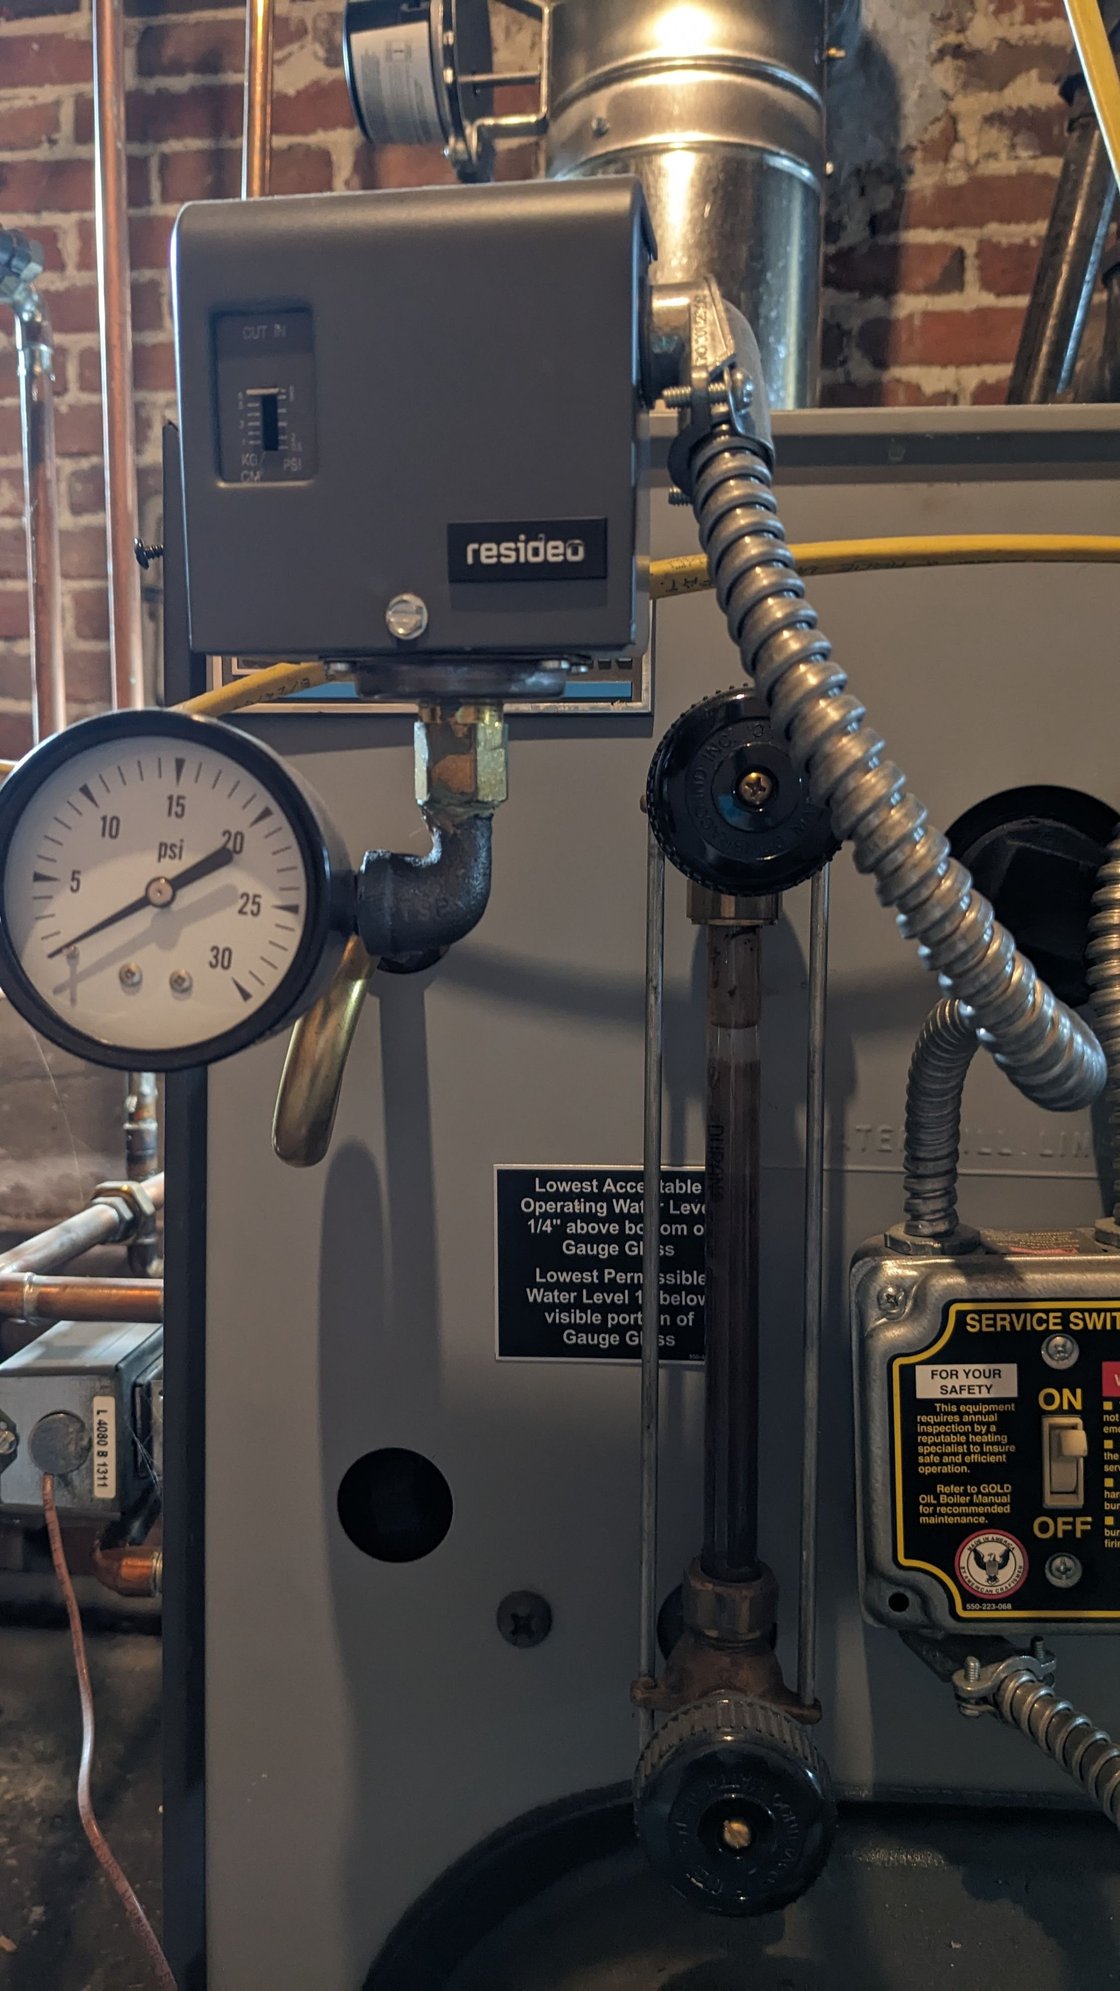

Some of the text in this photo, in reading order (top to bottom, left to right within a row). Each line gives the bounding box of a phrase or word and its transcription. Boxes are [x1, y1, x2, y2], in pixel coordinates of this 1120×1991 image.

[243, 325, 267, 340] CUT
[284, 458, 302, 471] PSI
[466, 534, 585, 565] resideo
[166, 794, 186, 818] 15
[100, 816, 120, 839] 10
[222, 830, 244, 854] 20
[158, 839, 184, 863] psi
[70, 870, 81, 893] 5
[238, 892, 261, 916] 25
[209, 947, 232, 970] 30
[535, 1177, 702, 1194] Lowest Accetable
[520, 1198, 607, 1217] Operating
[527, 1218, 705, 1236] 1/4" above boom o
[562, 1239, 675, 1258] Gauge Glss
[535, 1268, 706, 1286] Lowest Permssible
[526, 1287, 577, 1303] Water
[582, 1288, 629, 1304] Level
[544, 1309, 695, 1328] visible portn of
[966, 1312, 1063, 1332] SERVICE
[562, 1329, 620, 1348] Gauge
[931, 1368, 1002, 1380] FOR YOUR
[940, 1384, 993, 1395] SAFETY
[1038, 1387, 1083, 1411] ON
[934, 1402, 1015, 1414] This equipment
[917, 1413, 998, 1424] requires annual
[1103, 1413, 1119, 1422] not
[97, 1419, 108, 1447] 4080
[917, 1424, 971, 1434] inspection
[974, 1423, 987, 1434] by
[917, 1434, 1008, 1445] reputable heating
[918, 1443, 1016, 1454] specialist to insure
[1103, 1451, 1119, 1460] the
[918, 1453, 1007, 1463] safe and efficient
[97, 1461, 108, 1488] 1311
[918, 1464, 970, 1476] operation.
[937, 1484, 1012, 1493] Refer to GOLD
[919, 1494, 1011, 1504] OIL Boiler Manual
[919, 1504, 1011, 1514] for recommended
[919, 1514, 988, 1524] maintenance.
[1032, 1516, 1093, 1539] OFF
[967, 1538, 982, 1551] MADE
[990, 1536, 1016, 1551] AMERICA
